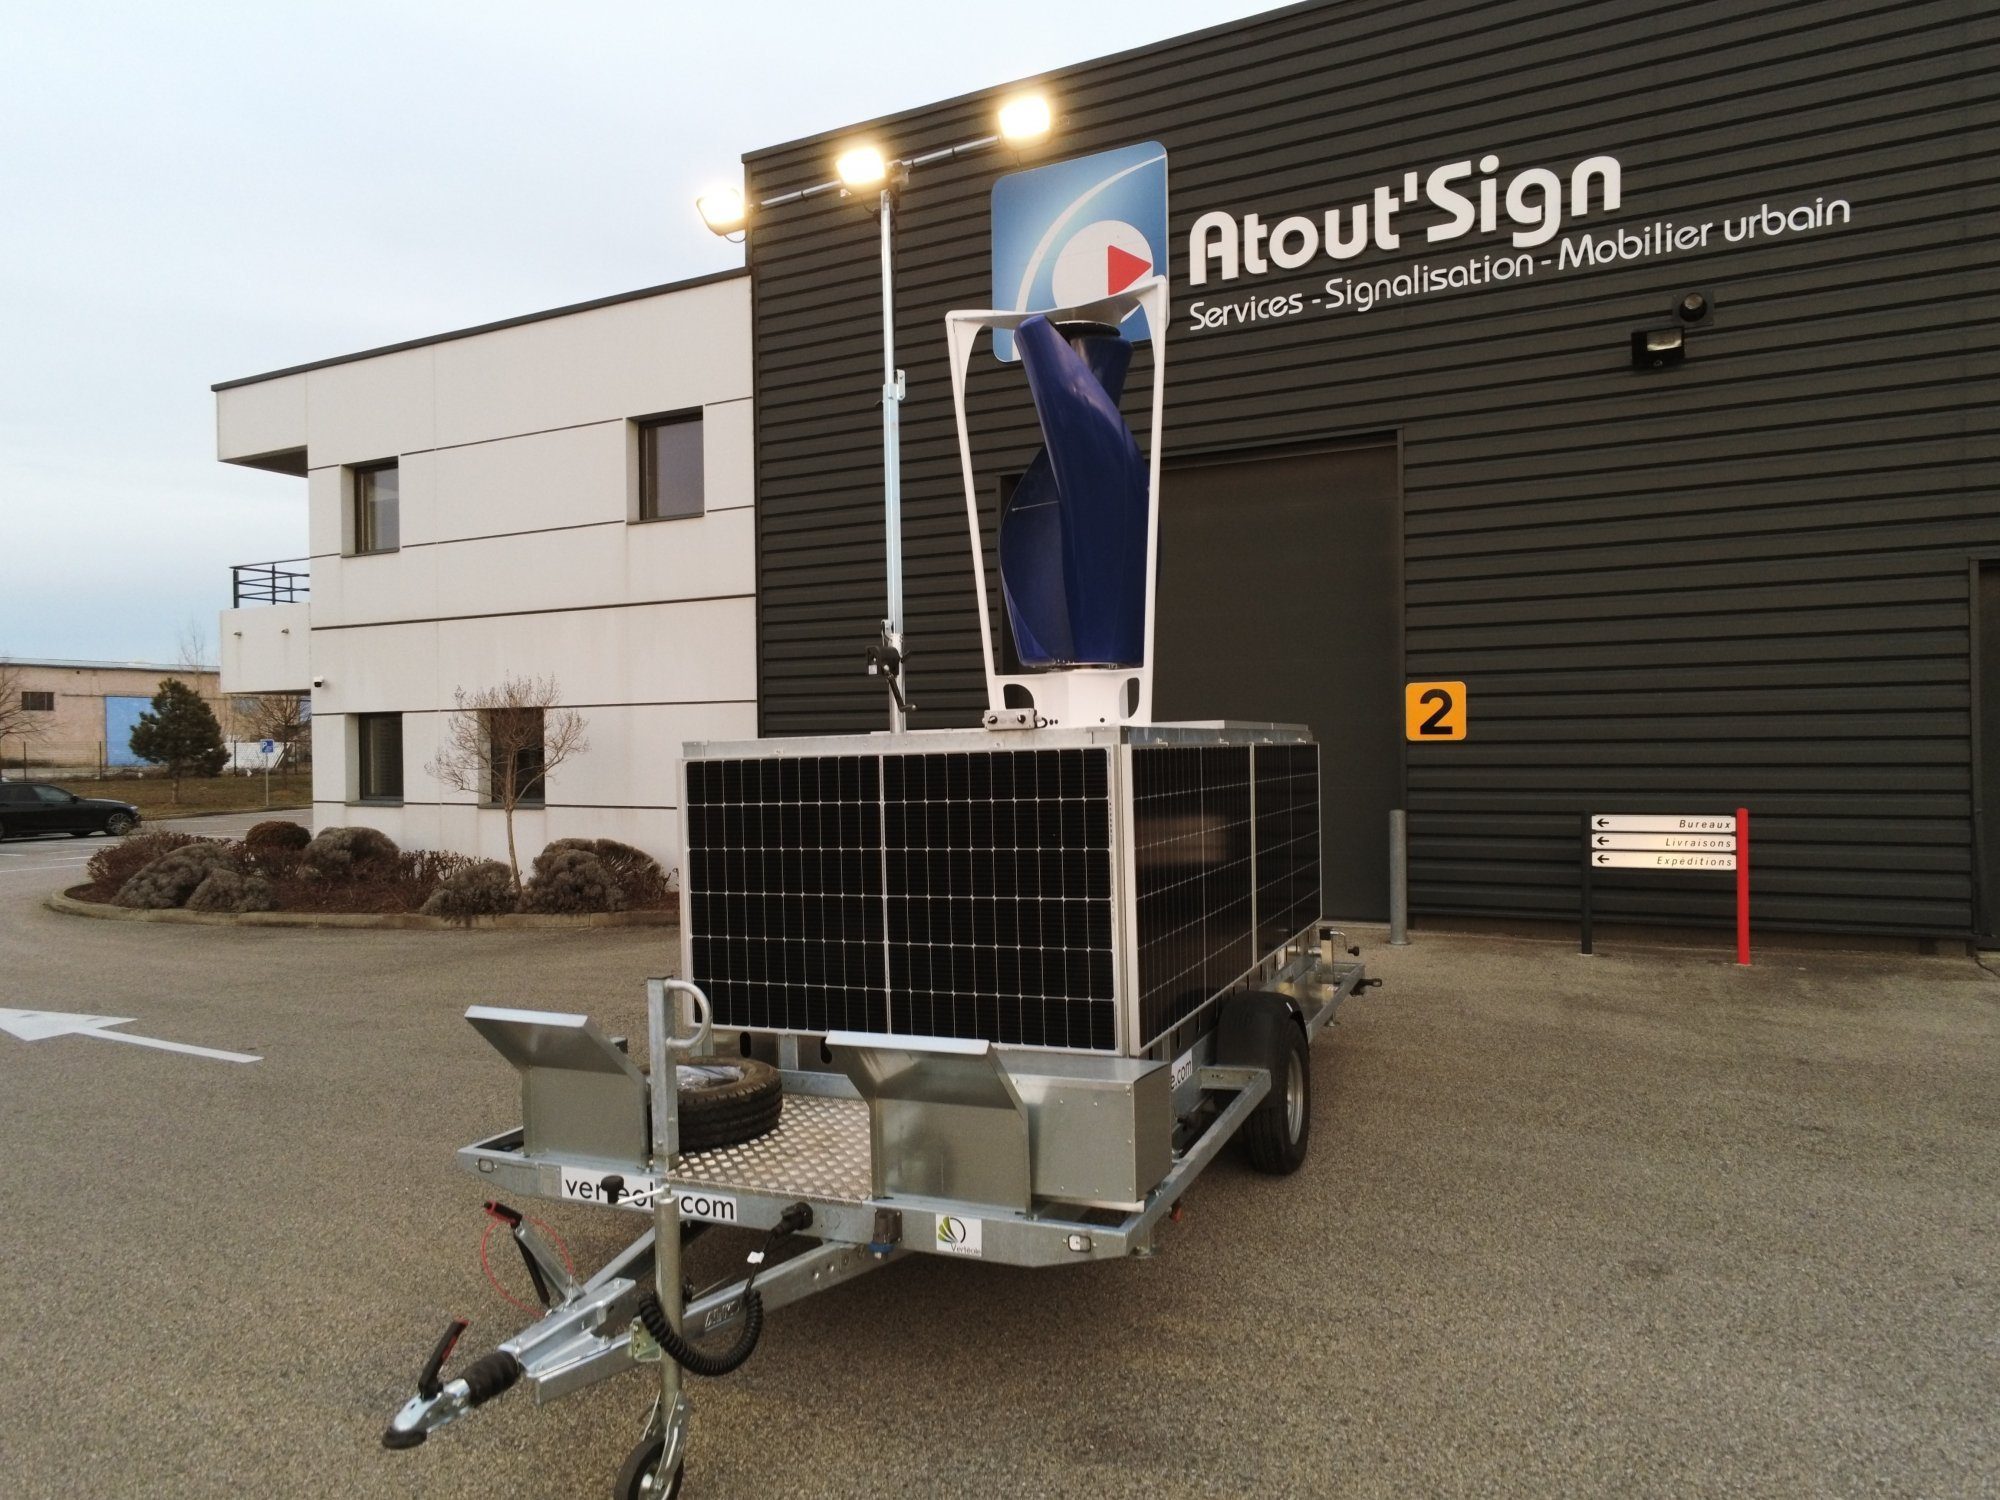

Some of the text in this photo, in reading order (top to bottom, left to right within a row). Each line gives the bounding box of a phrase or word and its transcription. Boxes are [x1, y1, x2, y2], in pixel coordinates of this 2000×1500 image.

[1189, 154, 1622, 286] Atout'Sign
[1189, 292, 1304, 331] Services
[1325, 252, 1535, 311] Signalisation
[1558, 222, 1715, 271] Mobilier
[1723, 197, 1851, 243] urbain
[1420, 688, 1453, 735] 2
[1679, 819, 1731, 829] Bureaux
[1665, 838, 1731, 848] Livraisons
[1656, 856, 1732, 867] Expéditions
